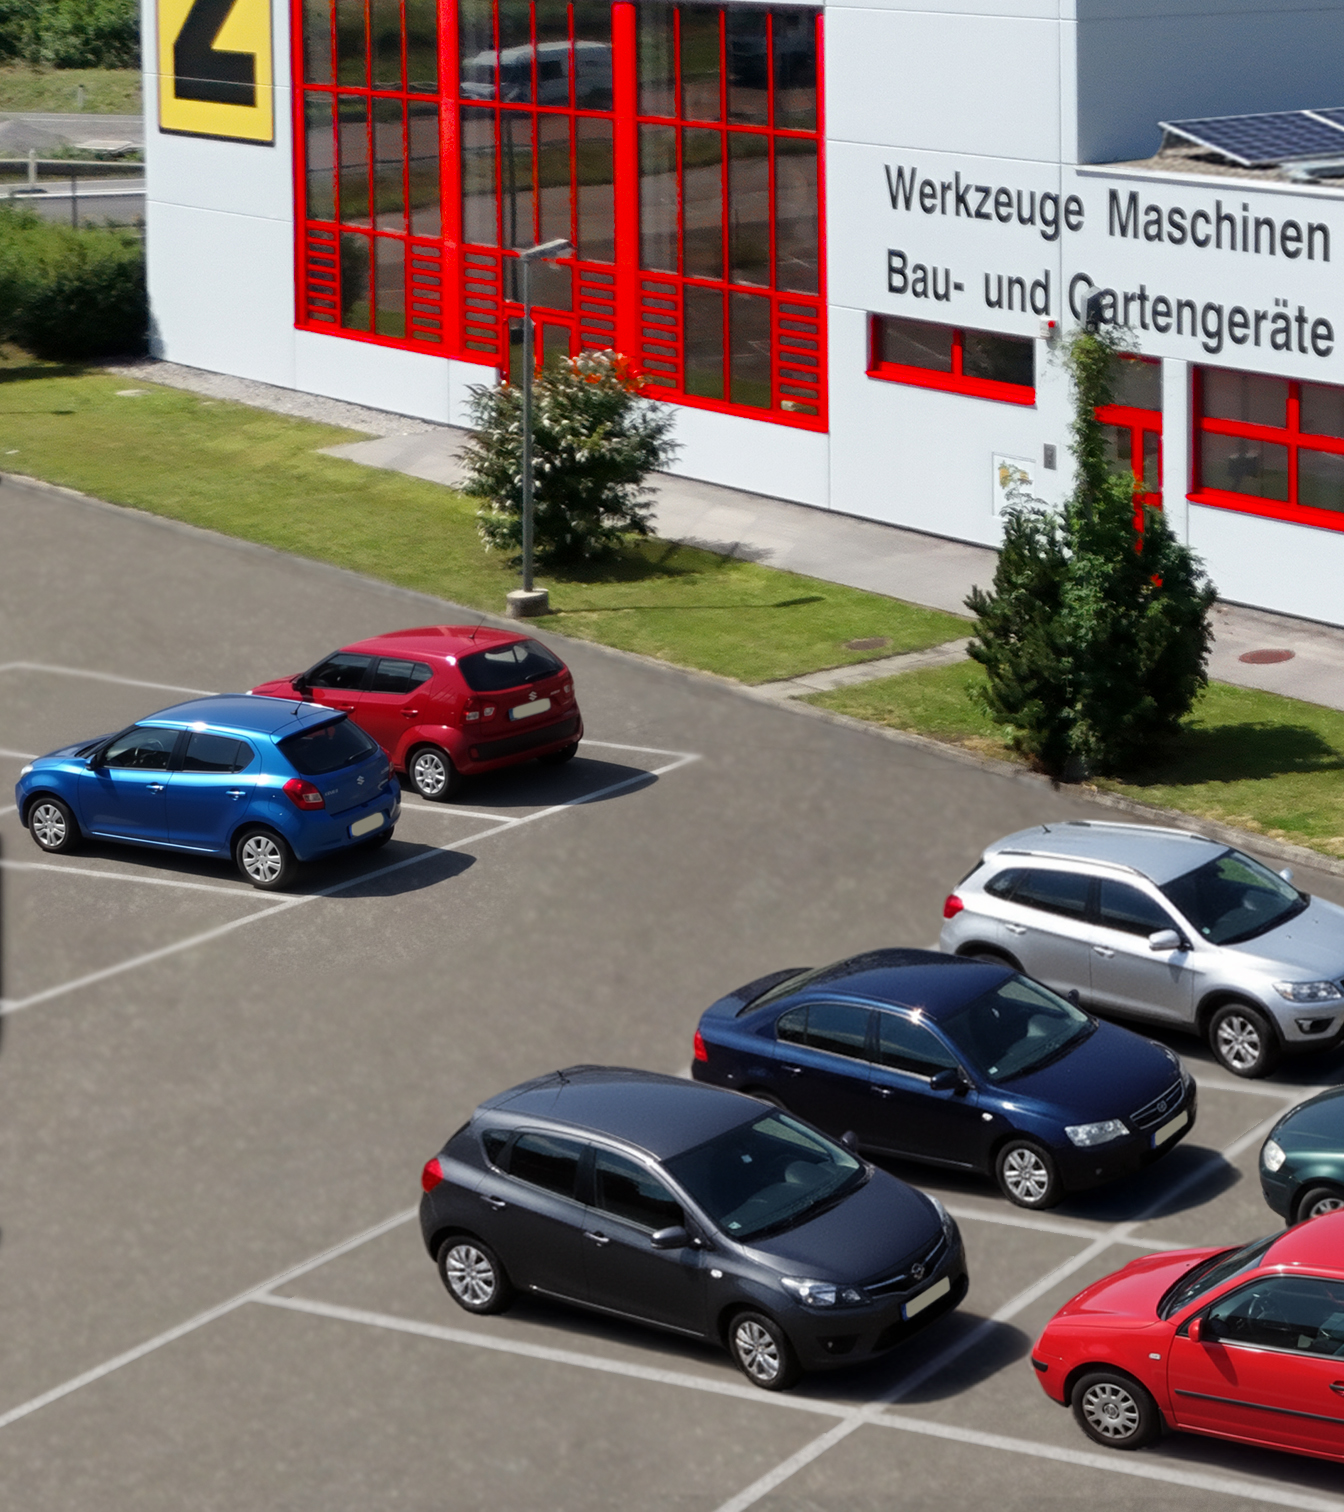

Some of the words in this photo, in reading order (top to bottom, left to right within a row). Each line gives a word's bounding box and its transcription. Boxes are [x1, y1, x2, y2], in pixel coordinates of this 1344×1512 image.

[884, 163, 1085, 241] Werkzeuge
[1108, 188, 1331, 262] Maschinen
[887, 248, 964, 302] Bau-
[984, 269, 1051, 316] und
[1068, 272, 1335, 357] Gartengeräte
